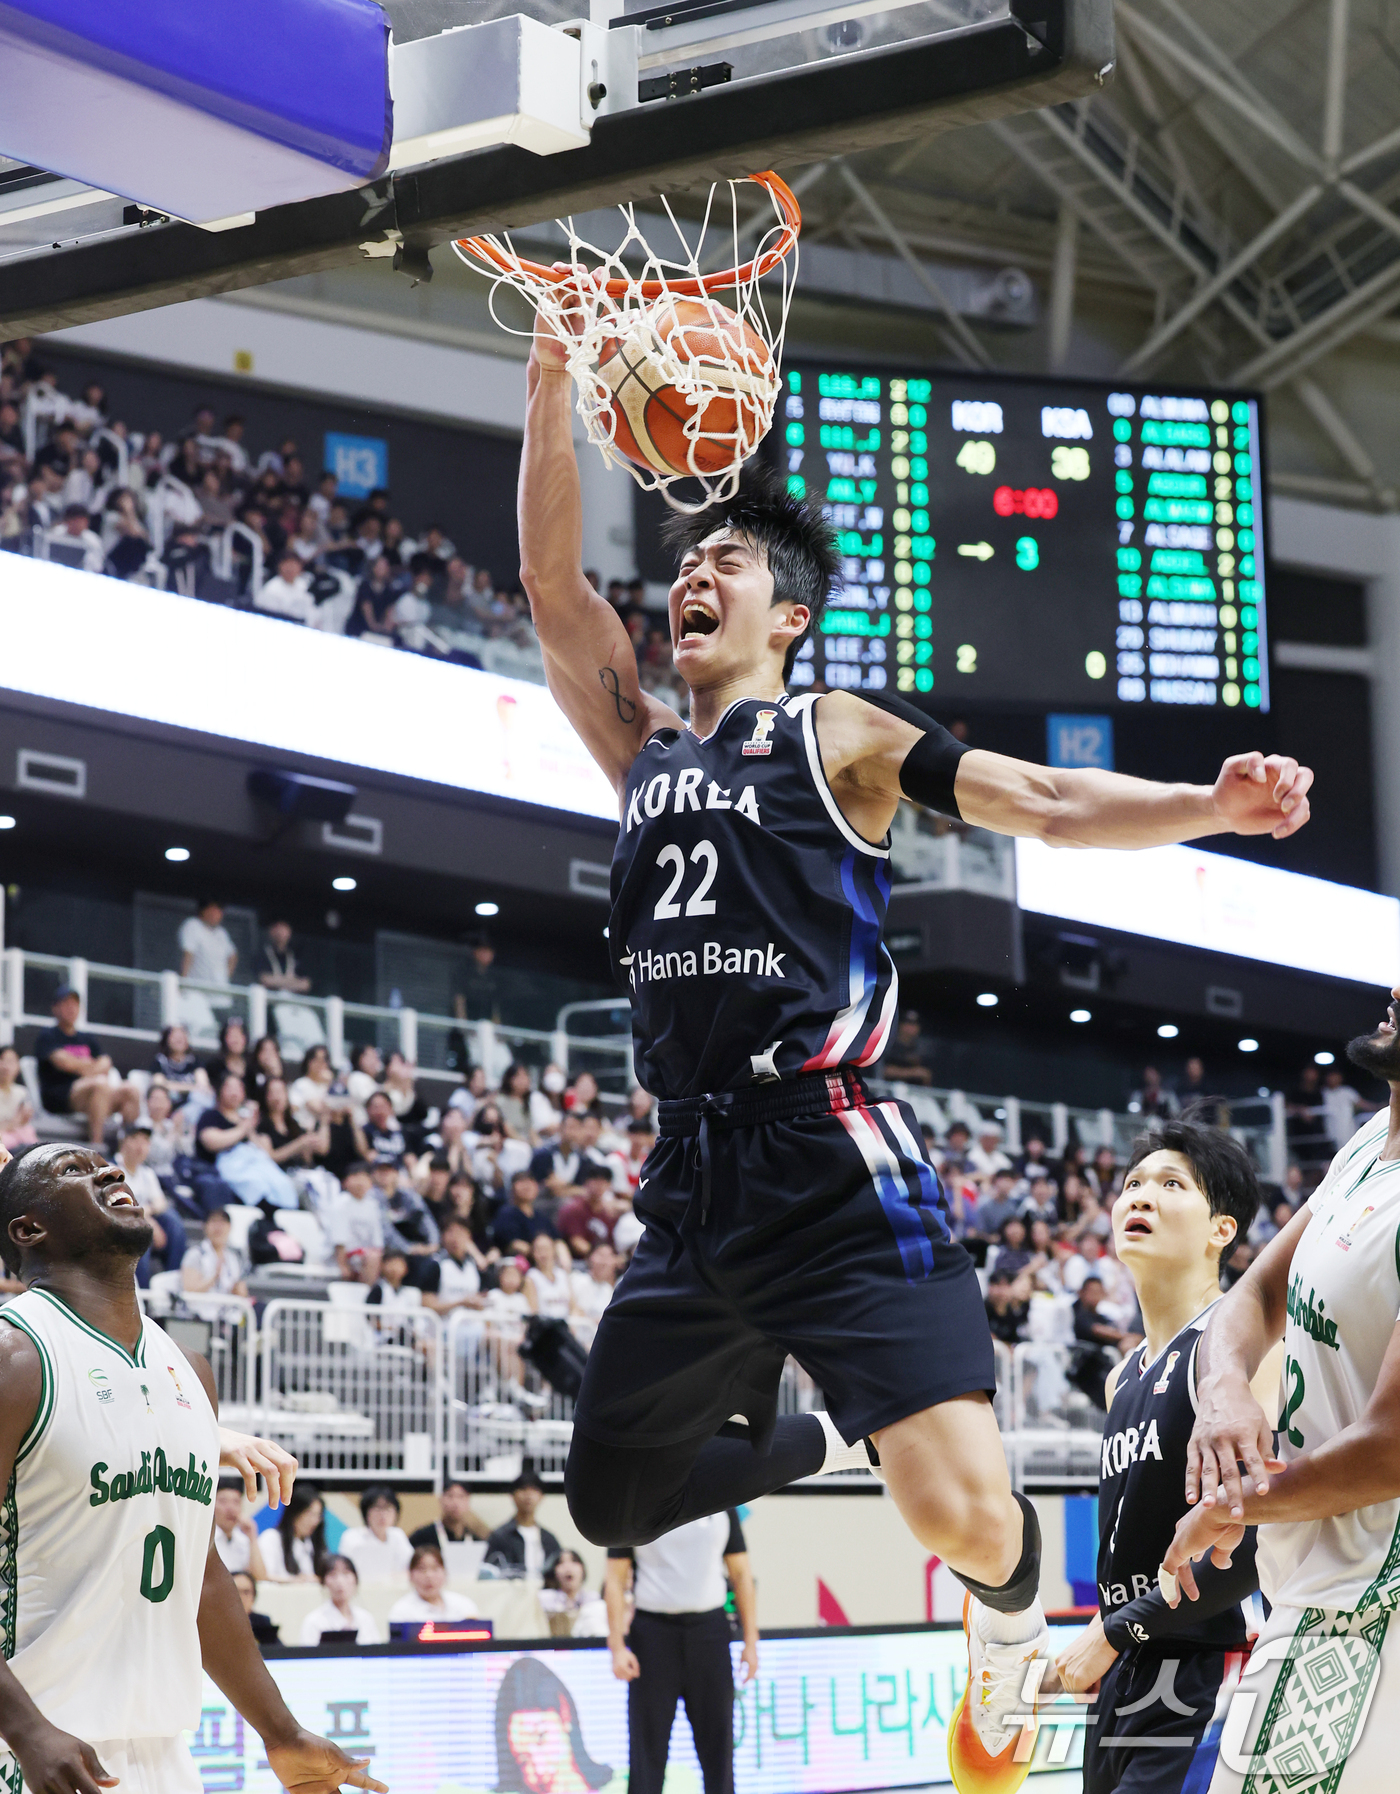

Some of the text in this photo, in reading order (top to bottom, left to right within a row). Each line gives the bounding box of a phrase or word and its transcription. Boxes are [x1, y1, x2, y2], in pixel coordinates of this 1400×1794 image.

[335, 446, 378, 488] H3
[956, 644, 1107, 679] 2 0
[1060, 727, 1102, 763] H2
[626, 767, 761, 833] KOREA
[653, 839, 719, 921] 22
[639, 942, 787, 984] Hana Bank
[96, 1389, 112, 1400] SBF
[1102, 1419, 1163, 1480] KORA
[90, 1446, 213, 1507] Saudi Arabia
[140, 1524, 175, 1603] 0
